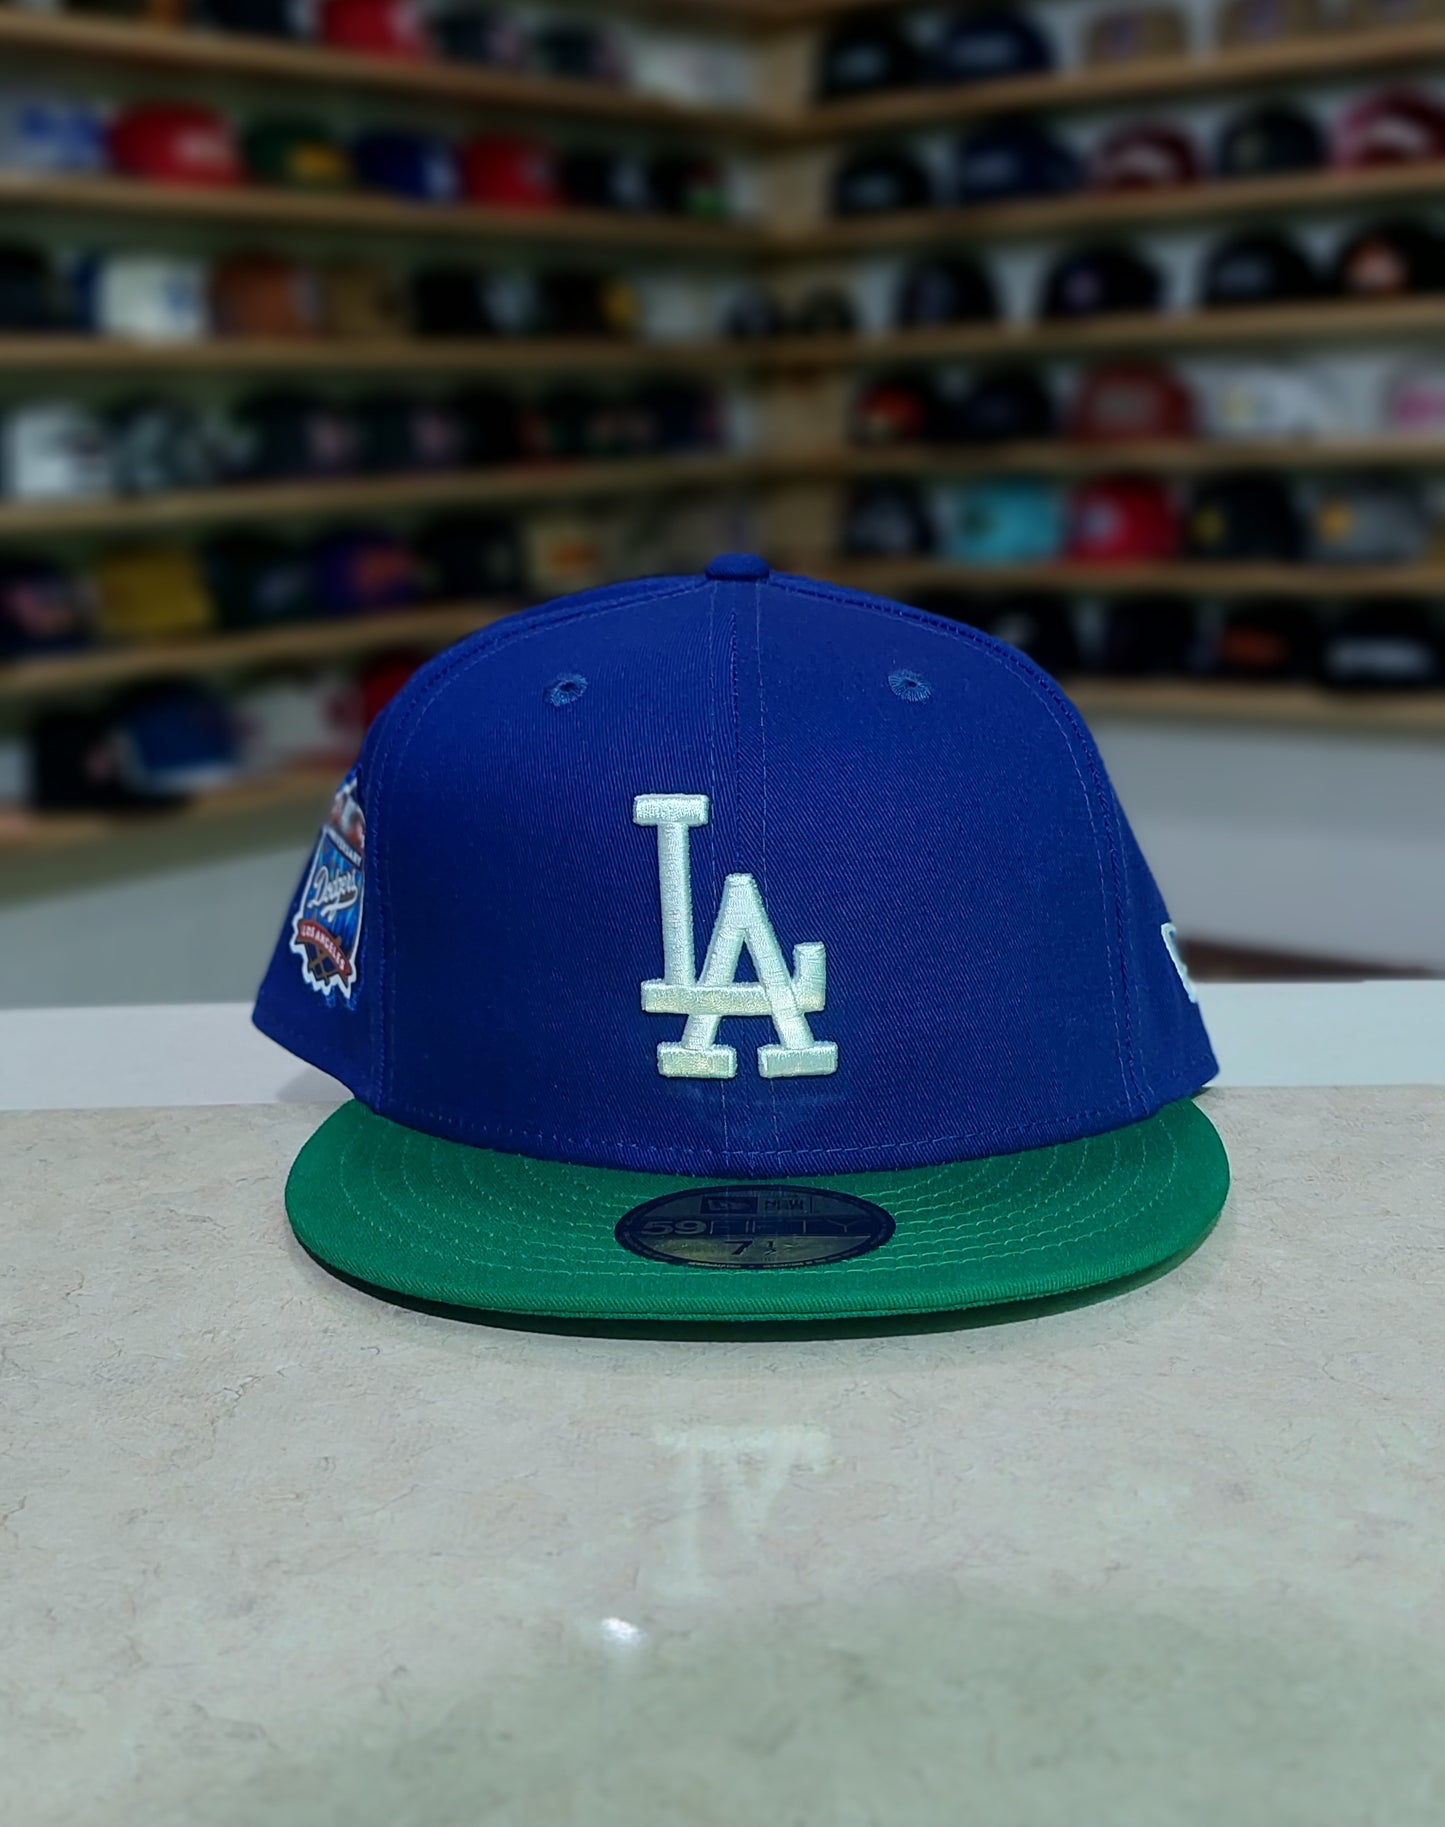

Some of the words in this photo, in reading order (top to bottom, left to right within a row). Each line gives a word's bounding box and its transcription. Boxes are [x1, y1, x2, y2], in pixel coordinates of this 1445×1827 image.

[300, 924, 316, 939] LOS
[314, 929, 346, 972] ANGELES
[633, 793, 838, 1079] LA
